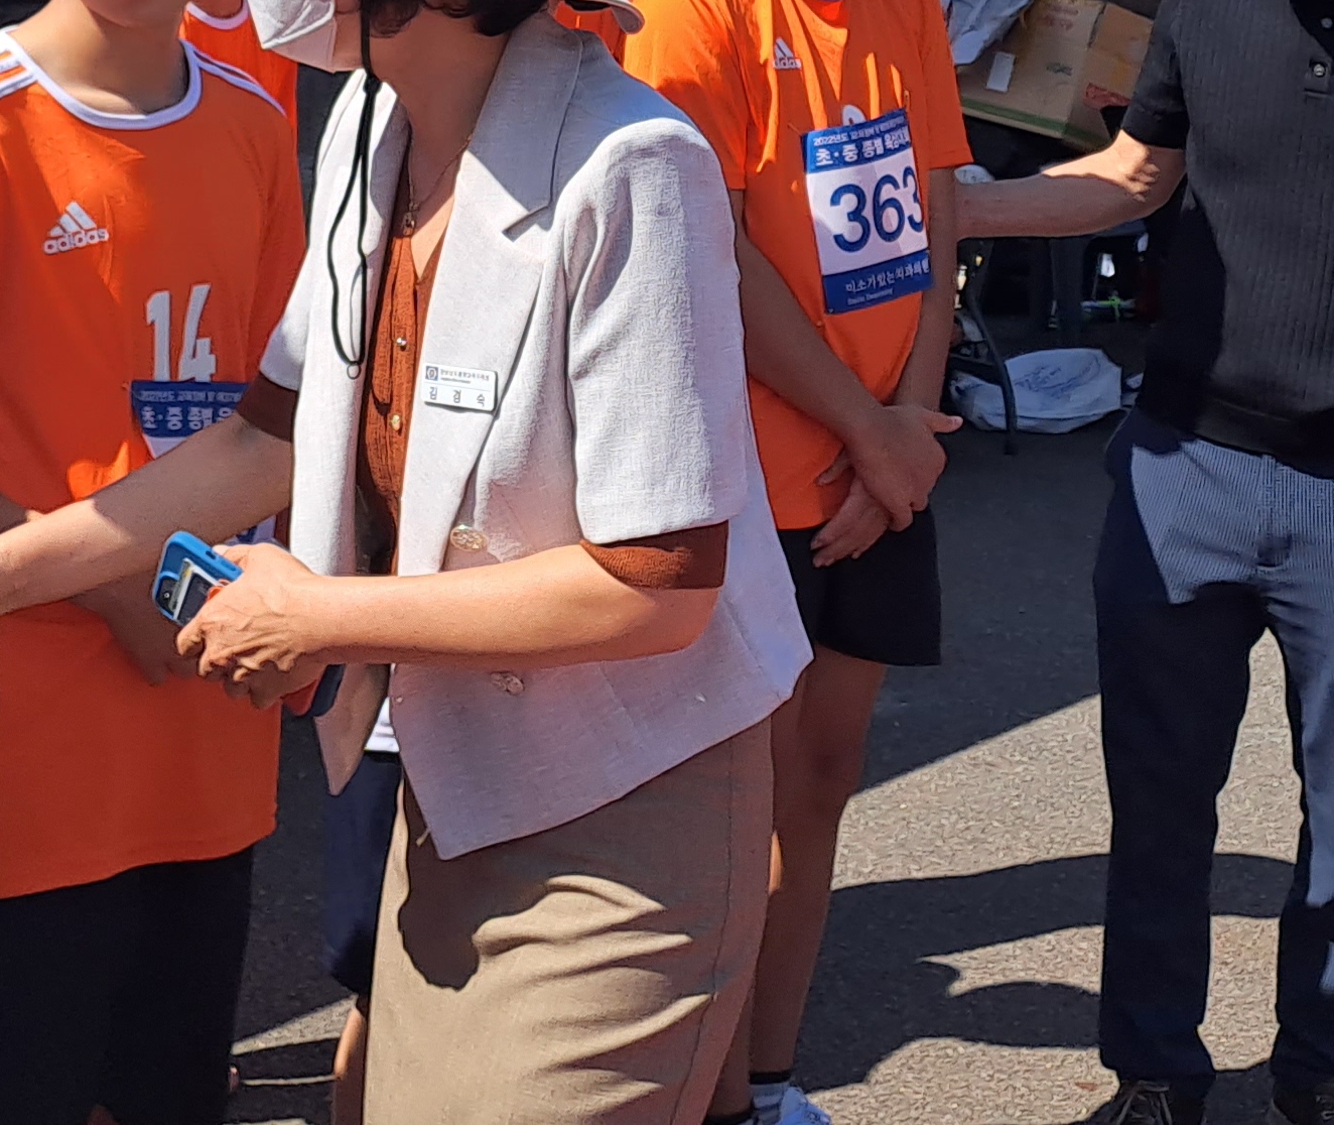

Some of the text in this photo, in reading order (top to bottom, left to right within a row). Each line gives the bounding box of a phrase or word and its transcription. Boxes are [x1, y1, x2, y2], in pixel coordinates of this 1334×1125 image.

[43, 228, 109, 255] adidas
[829, 166, 925, 253] 363
[146, 284, 216, 383] 14
